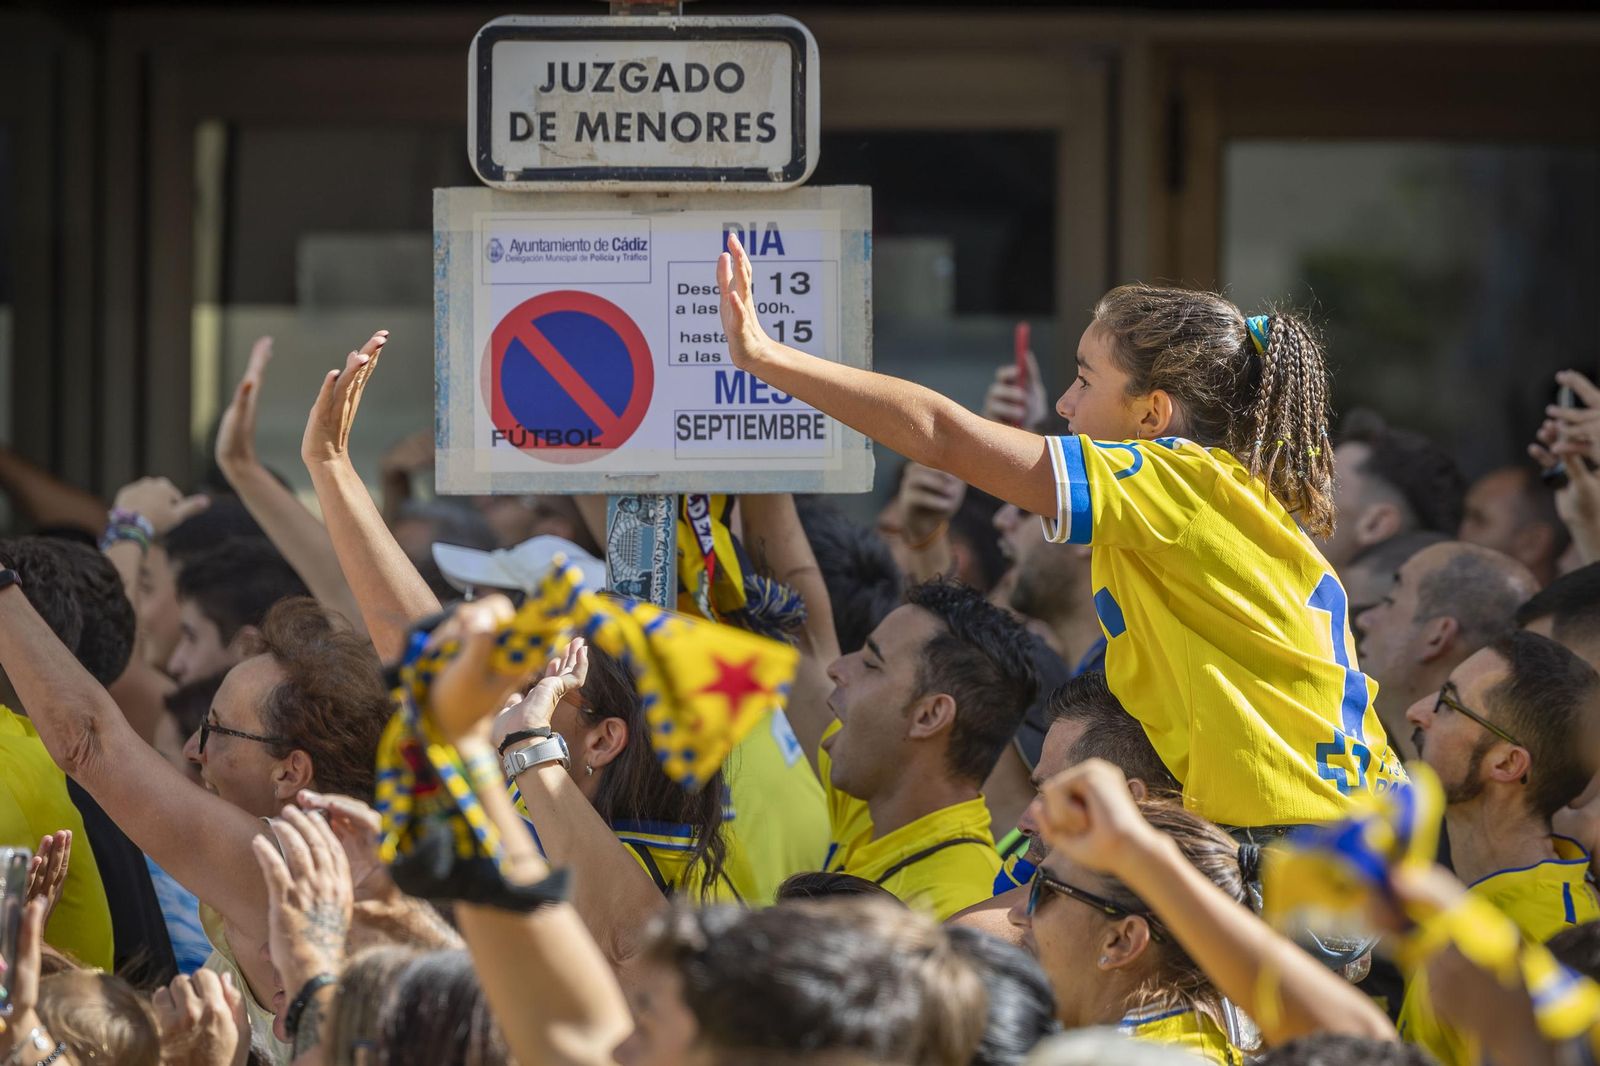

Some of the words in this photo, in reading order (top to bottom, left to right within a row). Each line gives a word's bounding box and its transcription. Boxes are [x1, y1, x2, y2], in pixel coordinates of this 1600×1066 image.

[539, 62, 745, 93] JUZGADO
[509, 111, 556, 142] DE
[575, 110, 777, 143] MENORES
[509, 237, 591, 255] Ayuntamiento
[594, 237, 609, 252] de
[612, 236, 648, 252] Cádiz
[722, 222, 785, 256] DIA
[505, 254, 543, 264] Delegación
[545, 254, 577, 263] Municipal
[580, 253, 588, 261] de
[769, 272, 811, 295] 13
[675, 304, 686, 315] a
[692, 302, 718, 315] las
[680, 331, 729, 343] hasta
[772, 320, 813, 343] 15
[678, 352, 689, 363] a
[695, 350, 722, 363] las
[491, 425, 602, 447] FÚTBOL
[676, 413, 826, 441] SEPTIEMBRE
